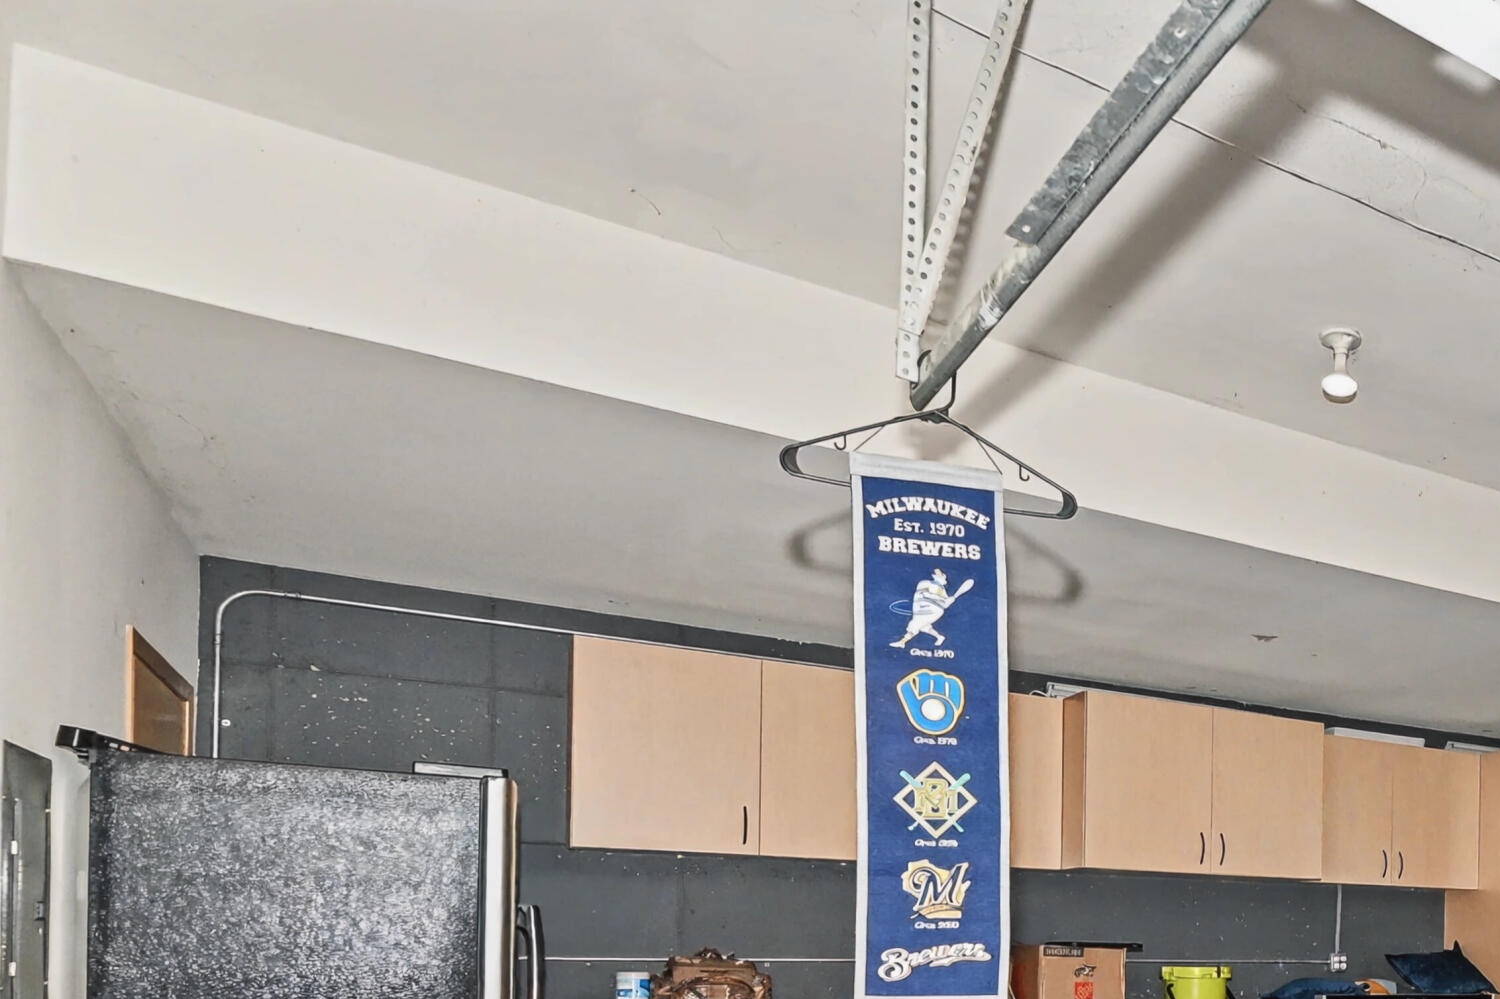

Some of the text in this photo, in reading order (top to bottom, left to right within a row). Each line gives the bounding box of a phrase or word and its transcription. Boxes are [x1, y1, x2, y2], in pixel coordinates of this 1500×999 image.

[865, 496, 991, 531] MILWAUKEE
[929, 521, 966, 538] 1970
[877, 535, 982, 561] BREWERS
